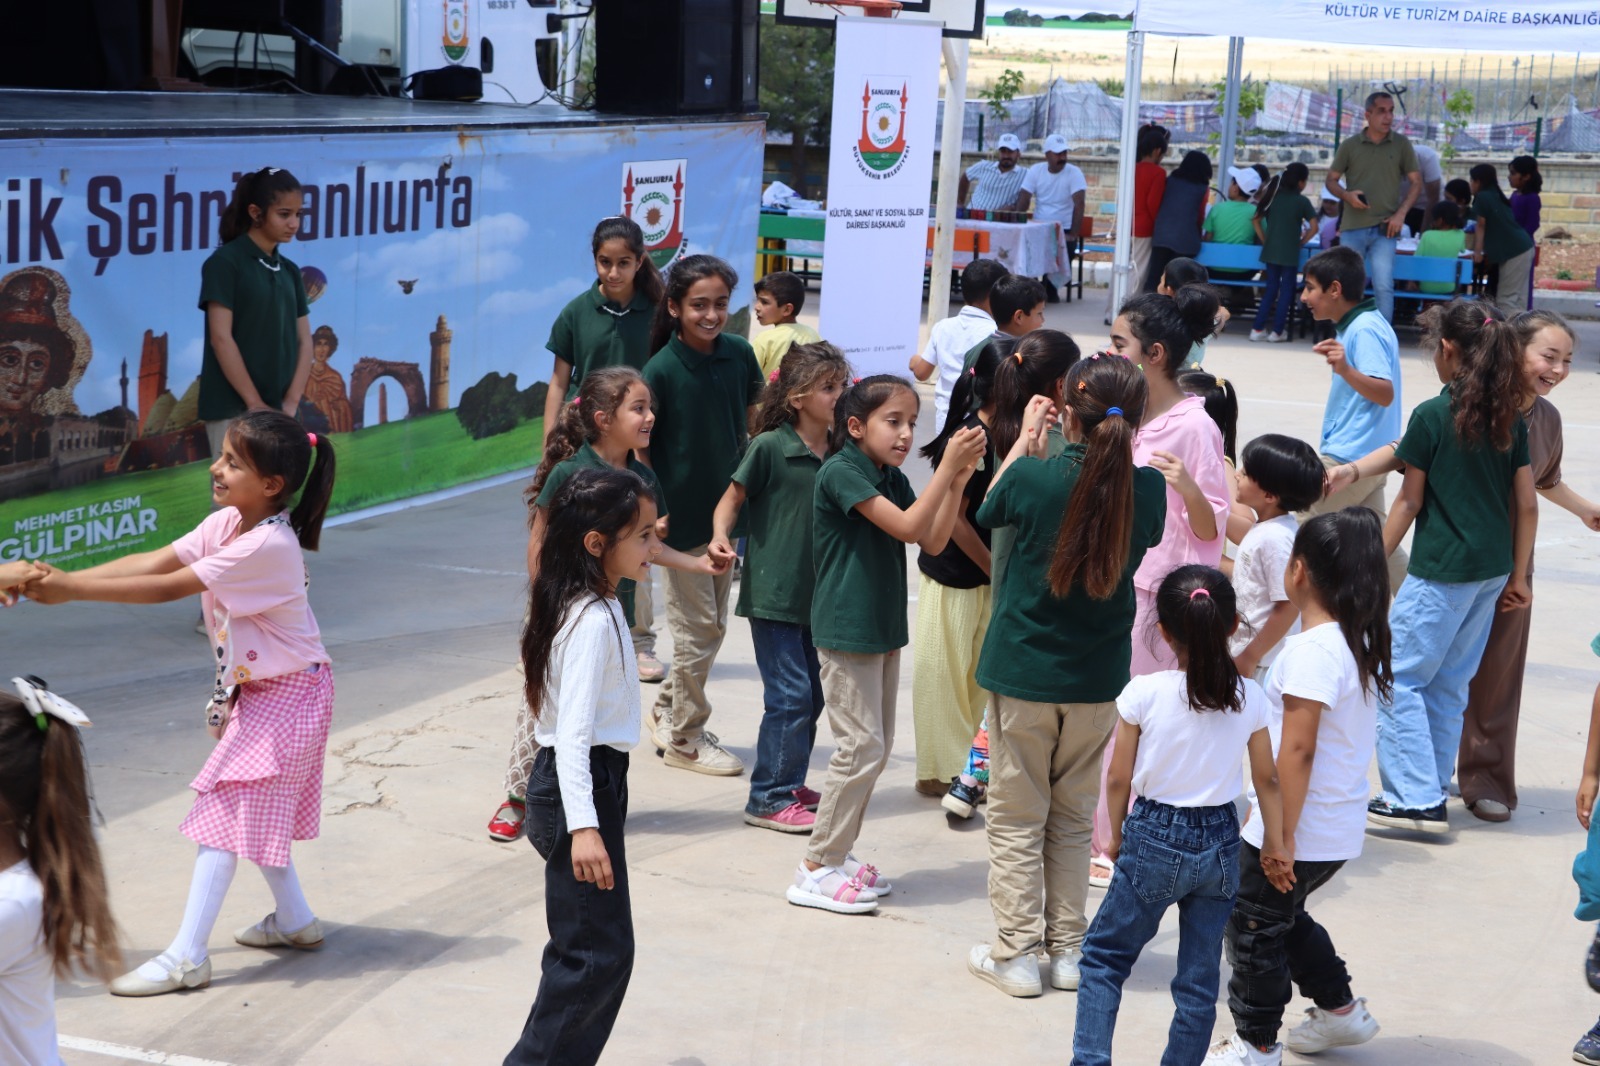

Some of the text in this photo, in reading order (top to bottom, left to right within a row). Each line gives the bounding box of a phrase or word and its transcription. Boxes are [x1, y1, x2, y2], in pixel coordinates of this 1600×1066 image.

[1325, 4, 1378, 18] KÜLTÜR
[1384, 7, 1401, 19] VE
[1407, 6, 1459, 22] TURİZM
[1464, 9, 1507, 23] DAİRE
[871, 88, 900, 96] ŞANLIURFA
[635, 175, 673, 186] ŞANLIURFA
[0, 178, 64, 264] ik
[296, 165, 473, 241] anlıurfa
[829, 207, 924, 218] KÜLTÜR, SANAT VE SOSYAL İŞLER
[846, 219, 905, 229] DAİRESİ BAŞKANLIĞI
[15, 495, 142, 534] MEHMET KASIM
[0, 508, 158, 564] GÜLPINAR
